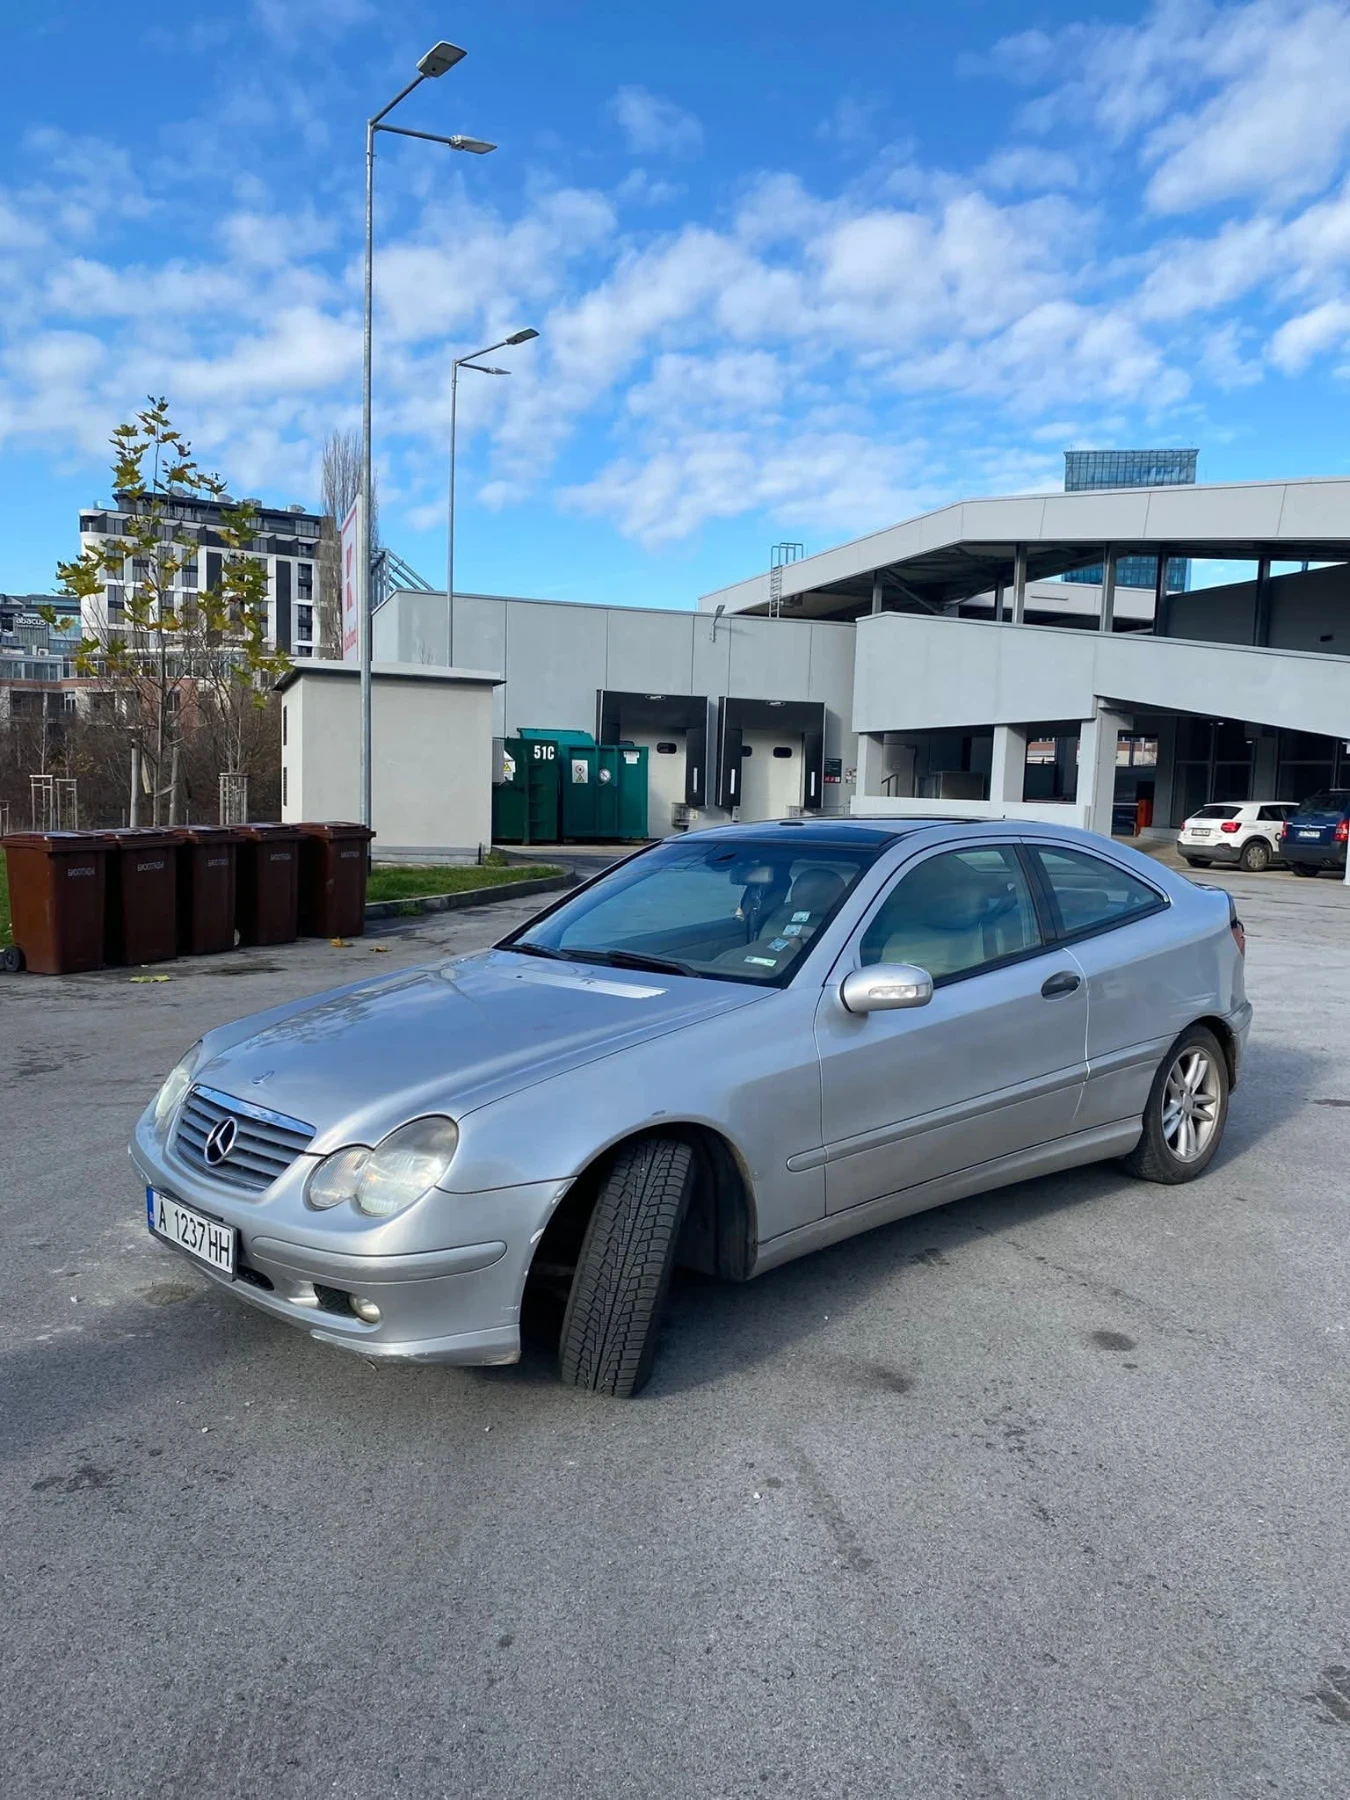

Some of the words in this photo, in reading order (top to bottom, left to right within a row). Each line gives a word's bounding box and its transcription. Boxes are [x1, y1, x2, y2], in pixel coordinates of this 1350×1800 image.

[16, 617, 46, 626] abacus
[533, 745, 555, 760] 51C
[159, 1200, 167, 1232] A
[174, 1209, 206, 1252] 1237
